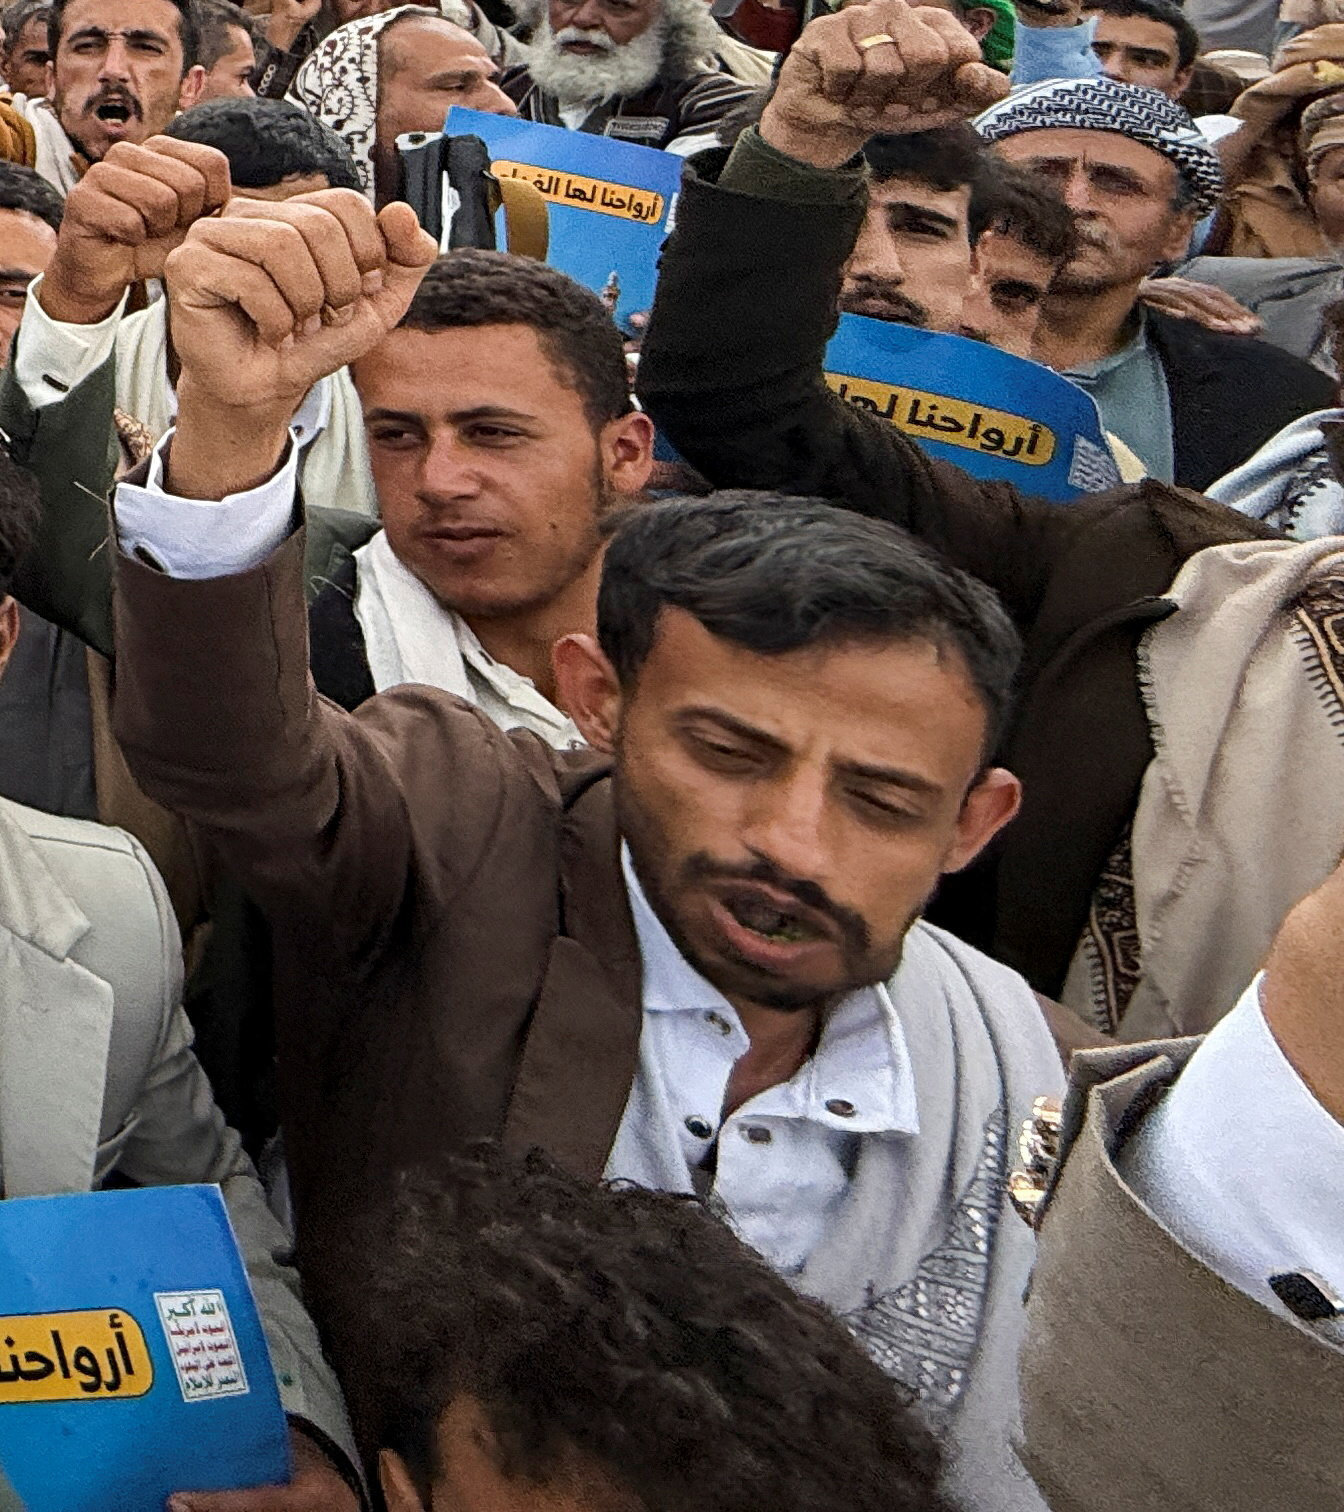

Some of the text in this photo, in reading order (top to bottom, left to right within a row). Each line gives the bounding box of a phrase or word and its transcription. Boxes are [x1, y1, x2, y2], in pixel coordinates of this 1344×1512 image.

[564, 179, 597, 203] لها
[600, 187, 660, 221] أرواحنا
[907, 399, 1041, 458] أرواحنا
